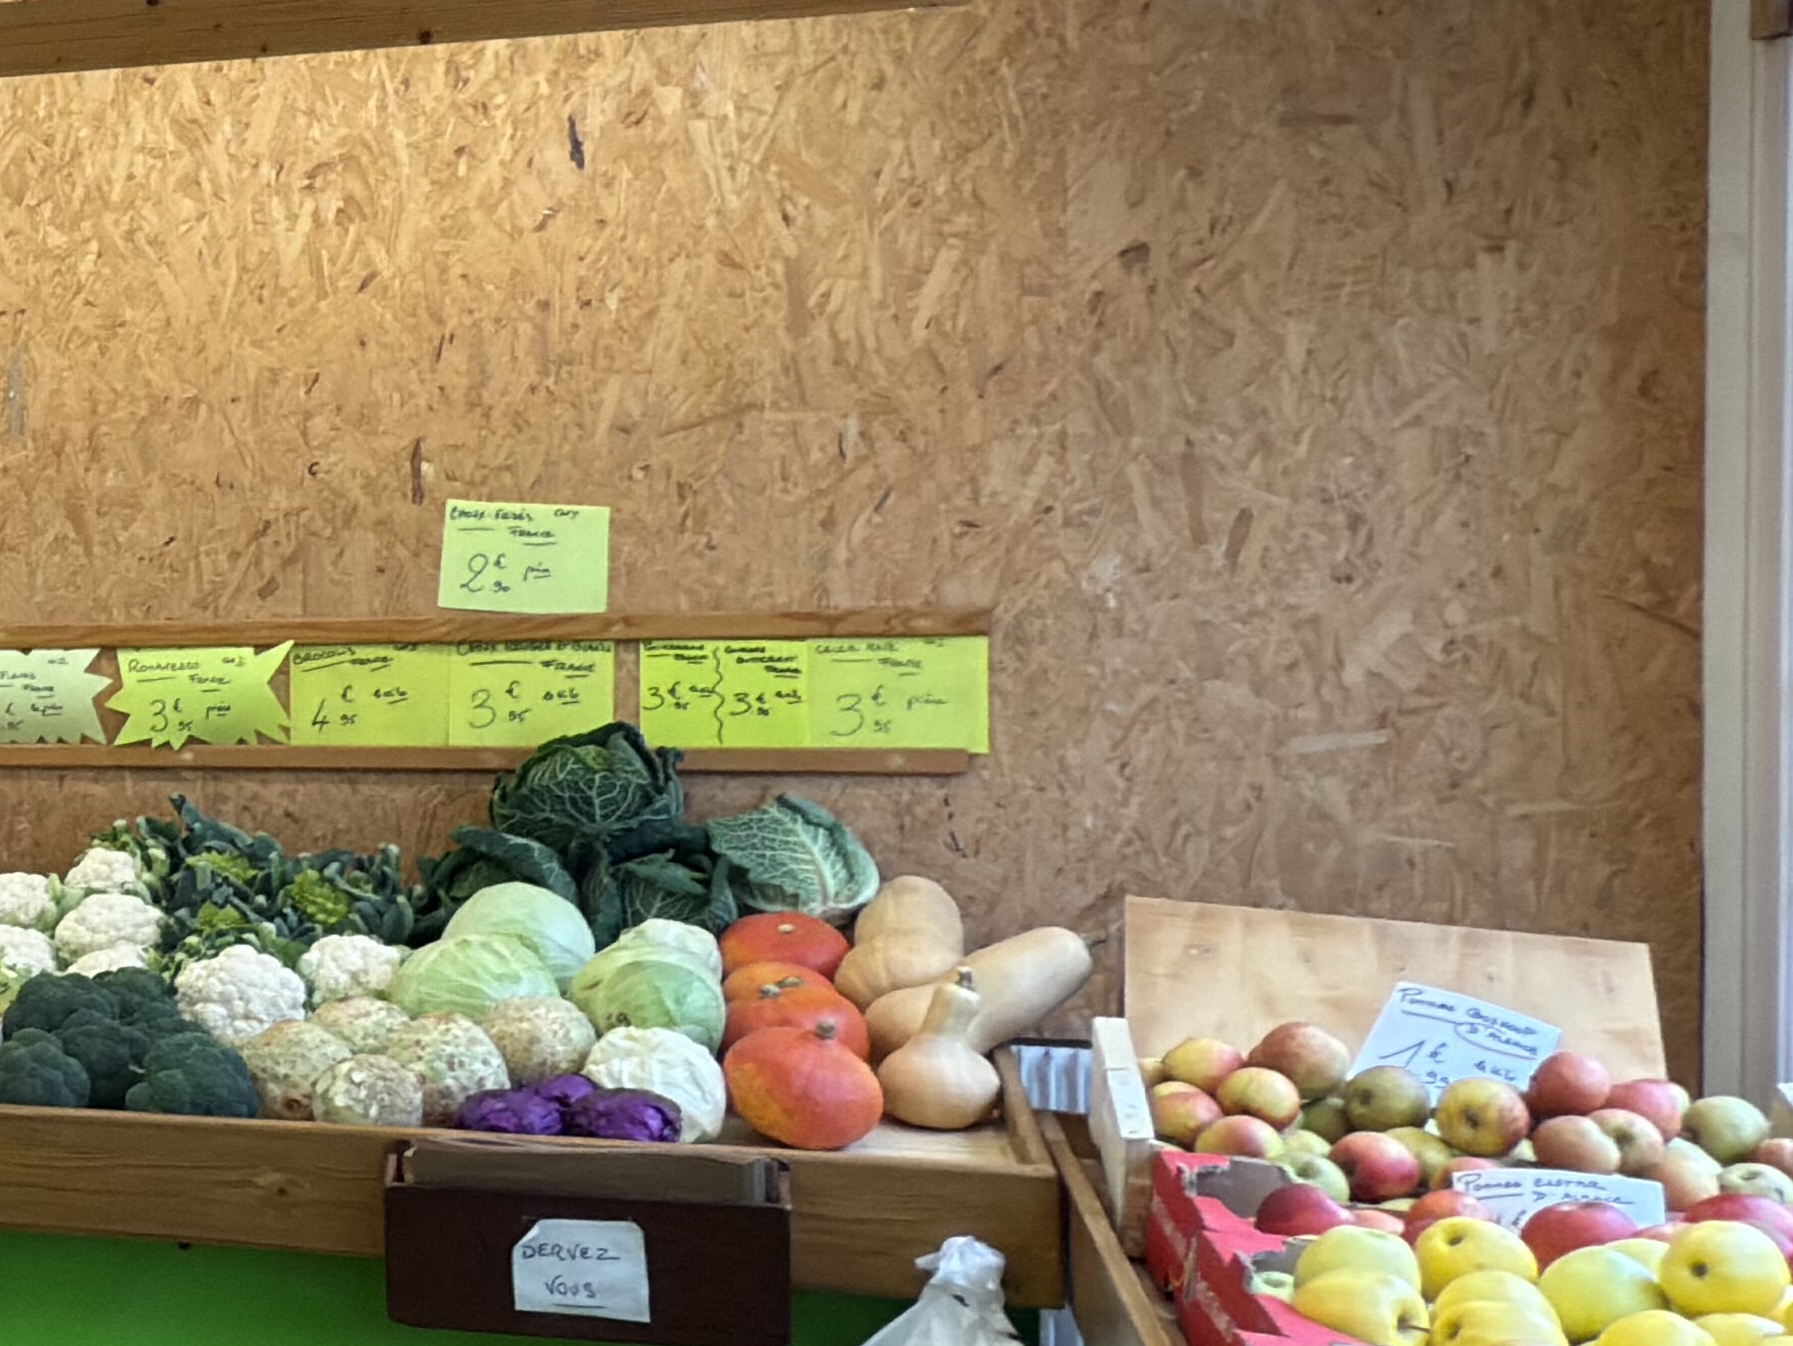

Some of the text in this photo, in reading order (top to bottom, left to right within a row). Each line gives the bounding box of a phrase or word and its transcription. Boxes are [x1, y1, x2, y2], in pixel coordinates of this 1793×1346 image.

[459, 553, 489, 593] 2
[149, 698, 169, 733] 3
[311, 698, 330, 733] 4
[468, 688, 498, 730] 3
[643, 686, 665, 711] 3
[729, 692, 753, 716] 3
[828, 692, 865, 737] 3
